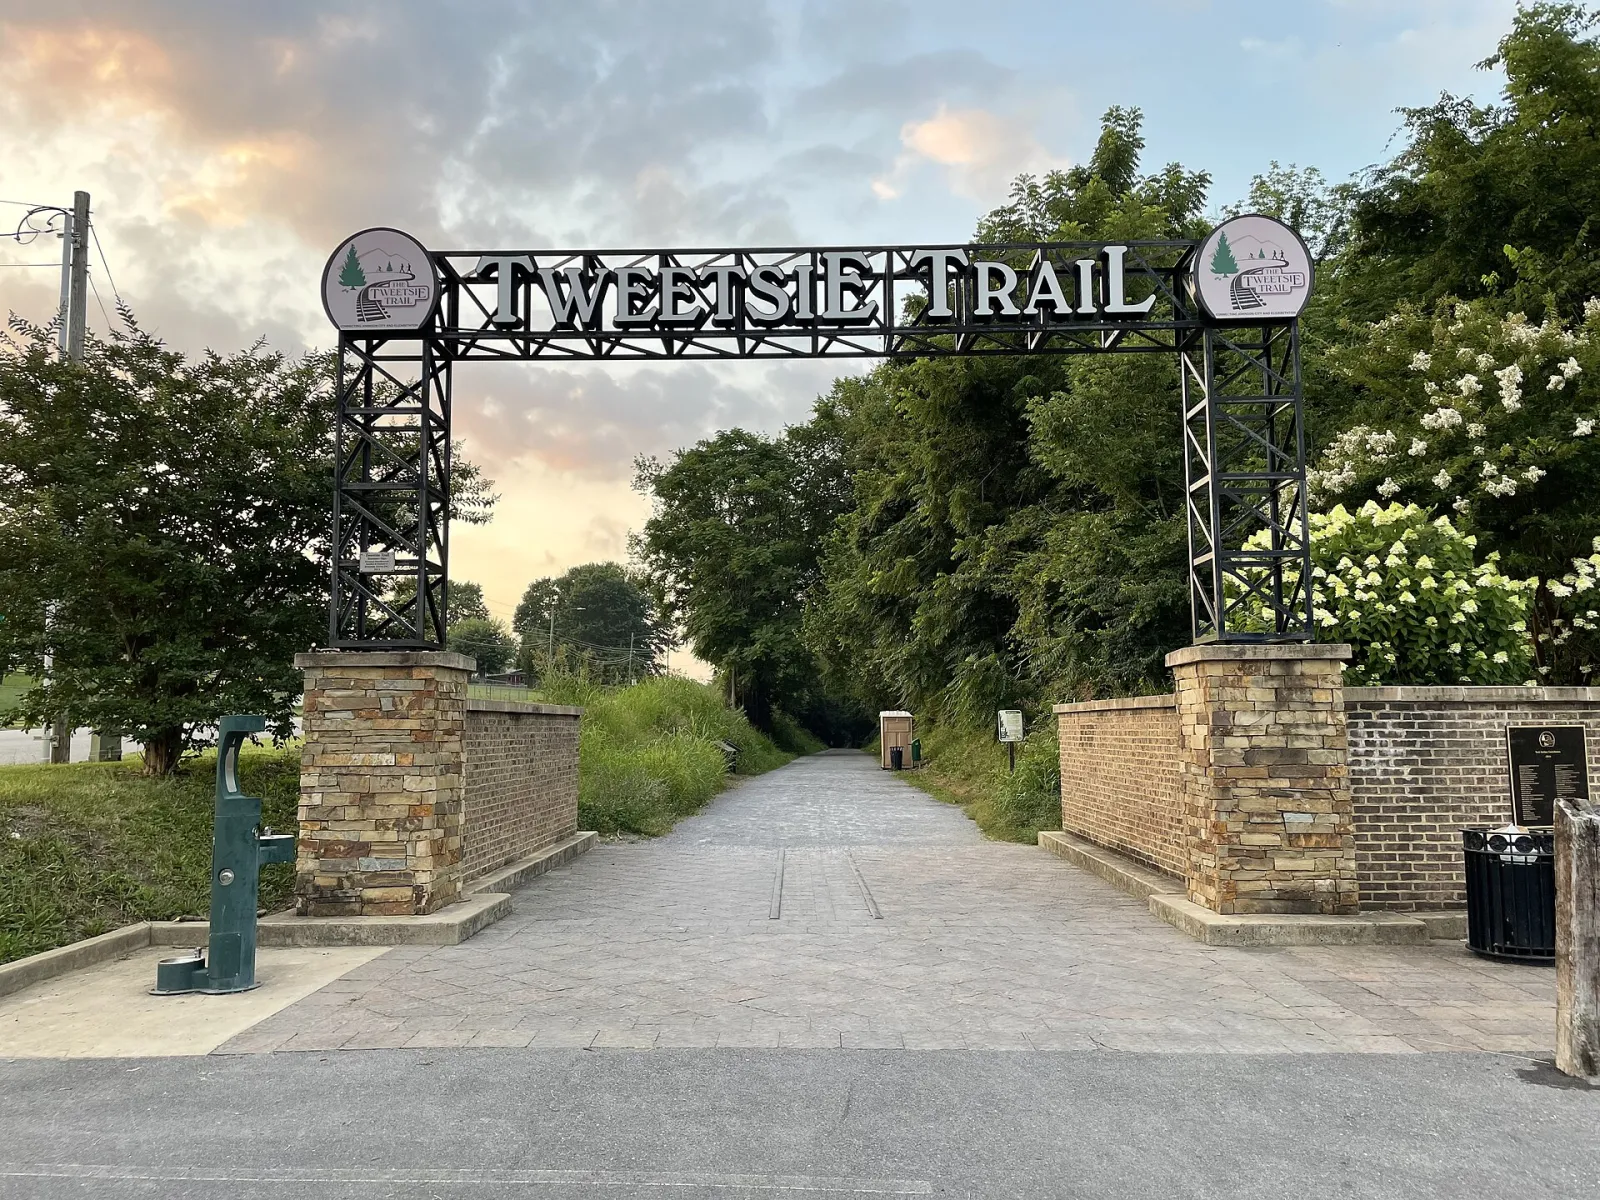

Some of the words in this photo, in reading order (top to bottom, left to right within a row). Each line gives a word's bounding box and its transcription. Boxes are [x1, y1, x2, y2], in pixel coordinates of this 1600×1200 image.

[475, 251, 877, 323] TWEETSIE
[909, 245, 1156, 317] TRAIL
[1243, 274, 1302, 286] TWEETSIE
[370, 287, 426, 299] TWEETSIE
[1258, 284, 1288, 292] TRAIL
[384, 297, 413, 305] TRAIL
